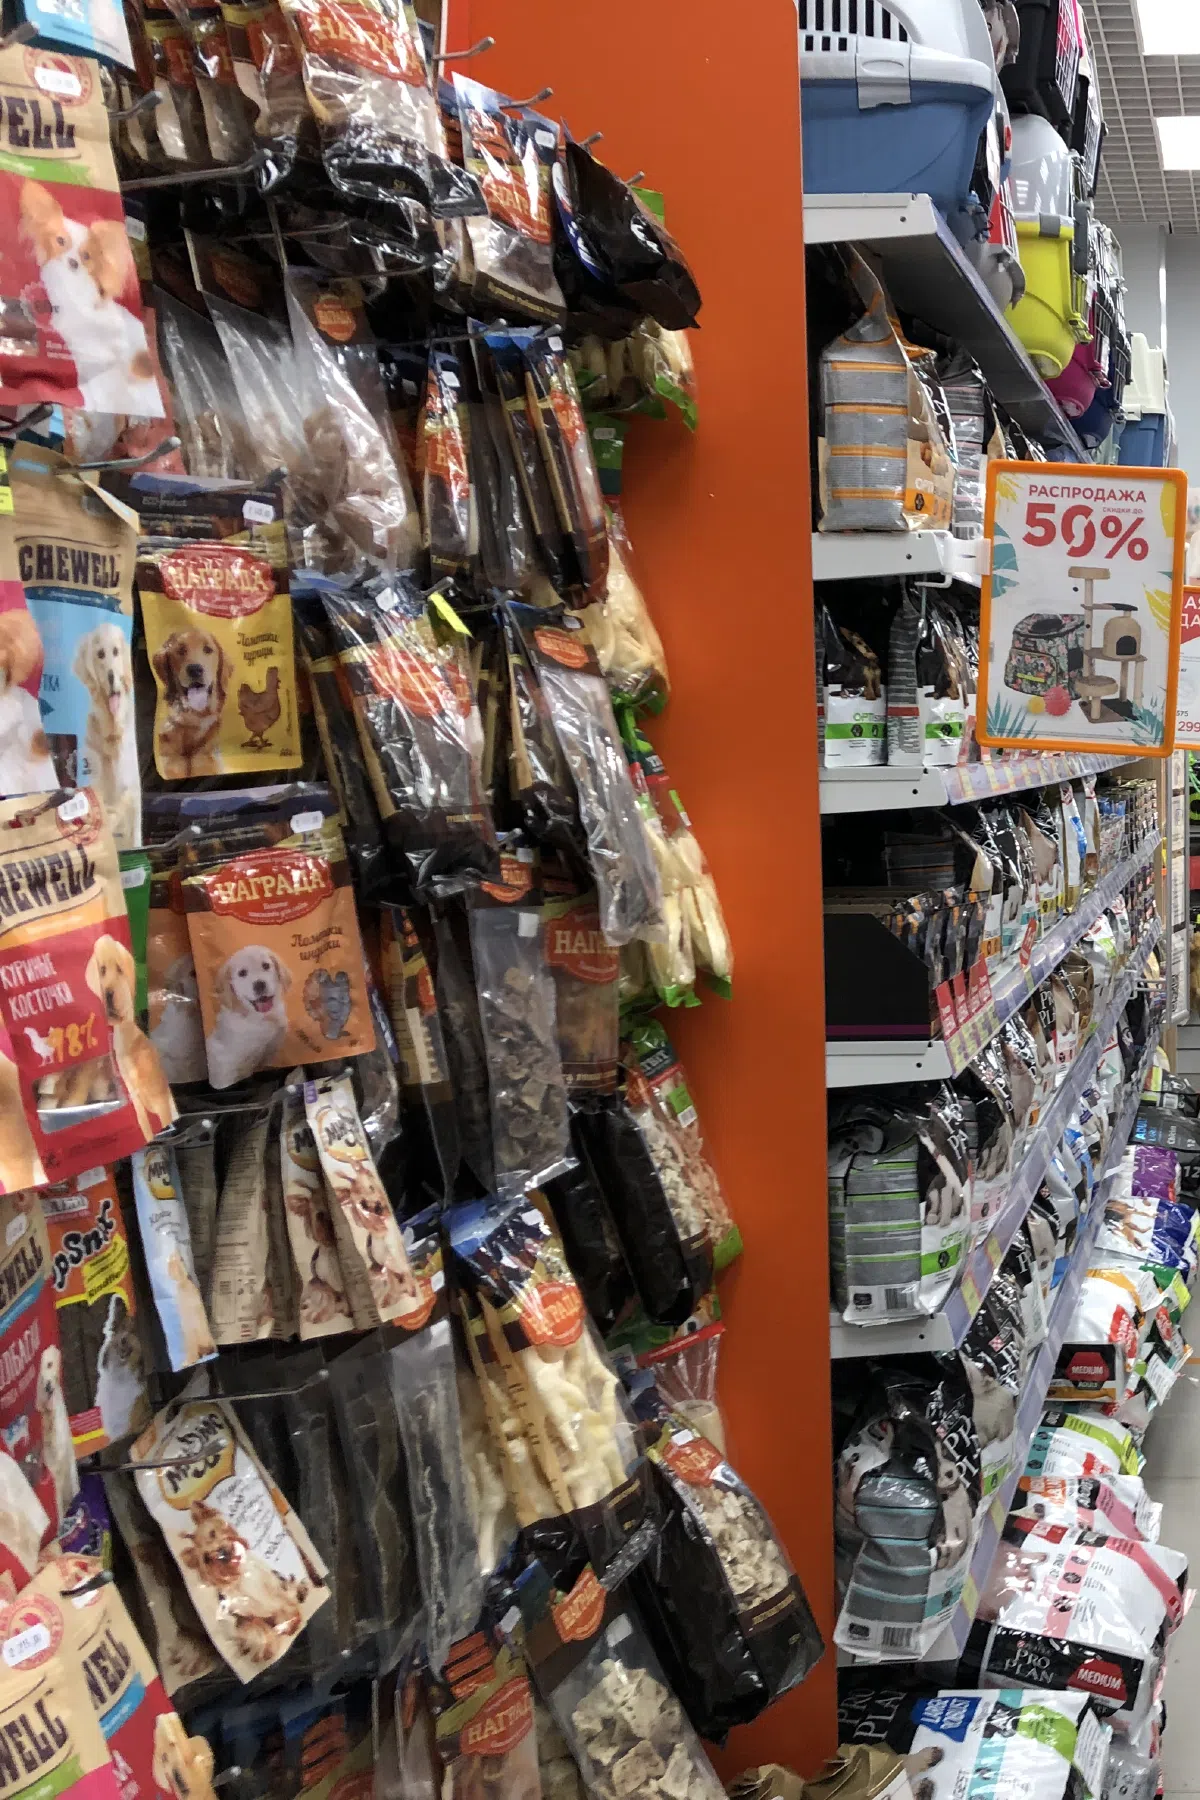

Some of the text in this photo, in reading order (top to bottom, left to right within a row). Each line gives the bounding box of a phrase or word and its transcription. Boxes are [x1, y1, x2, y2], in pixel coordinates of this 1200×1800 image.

[1029, 484, 1147, 503] РАСПРОДАЖА
[1022, 502, 1149, 561] 50%
[19, 544, 121, 588] CHEWELL
[168, 565, 269, 592] НАГРАДА
[1177, 721, 1200, 732] 299
[215, 868, 326, 904] НАГРАДА
[9, 981, 75, 1021] КОСТОЧКИ
[1183, 1165, 1200, 1178] 12
[1071, 1366, 1103, 1375] MEDIUM
[1014, 1648, 1050, 1669] PRO
[1004, 1658, 1054, 1684] PLAN
[1077, 1668, 1123, 1691] MEDIUM
